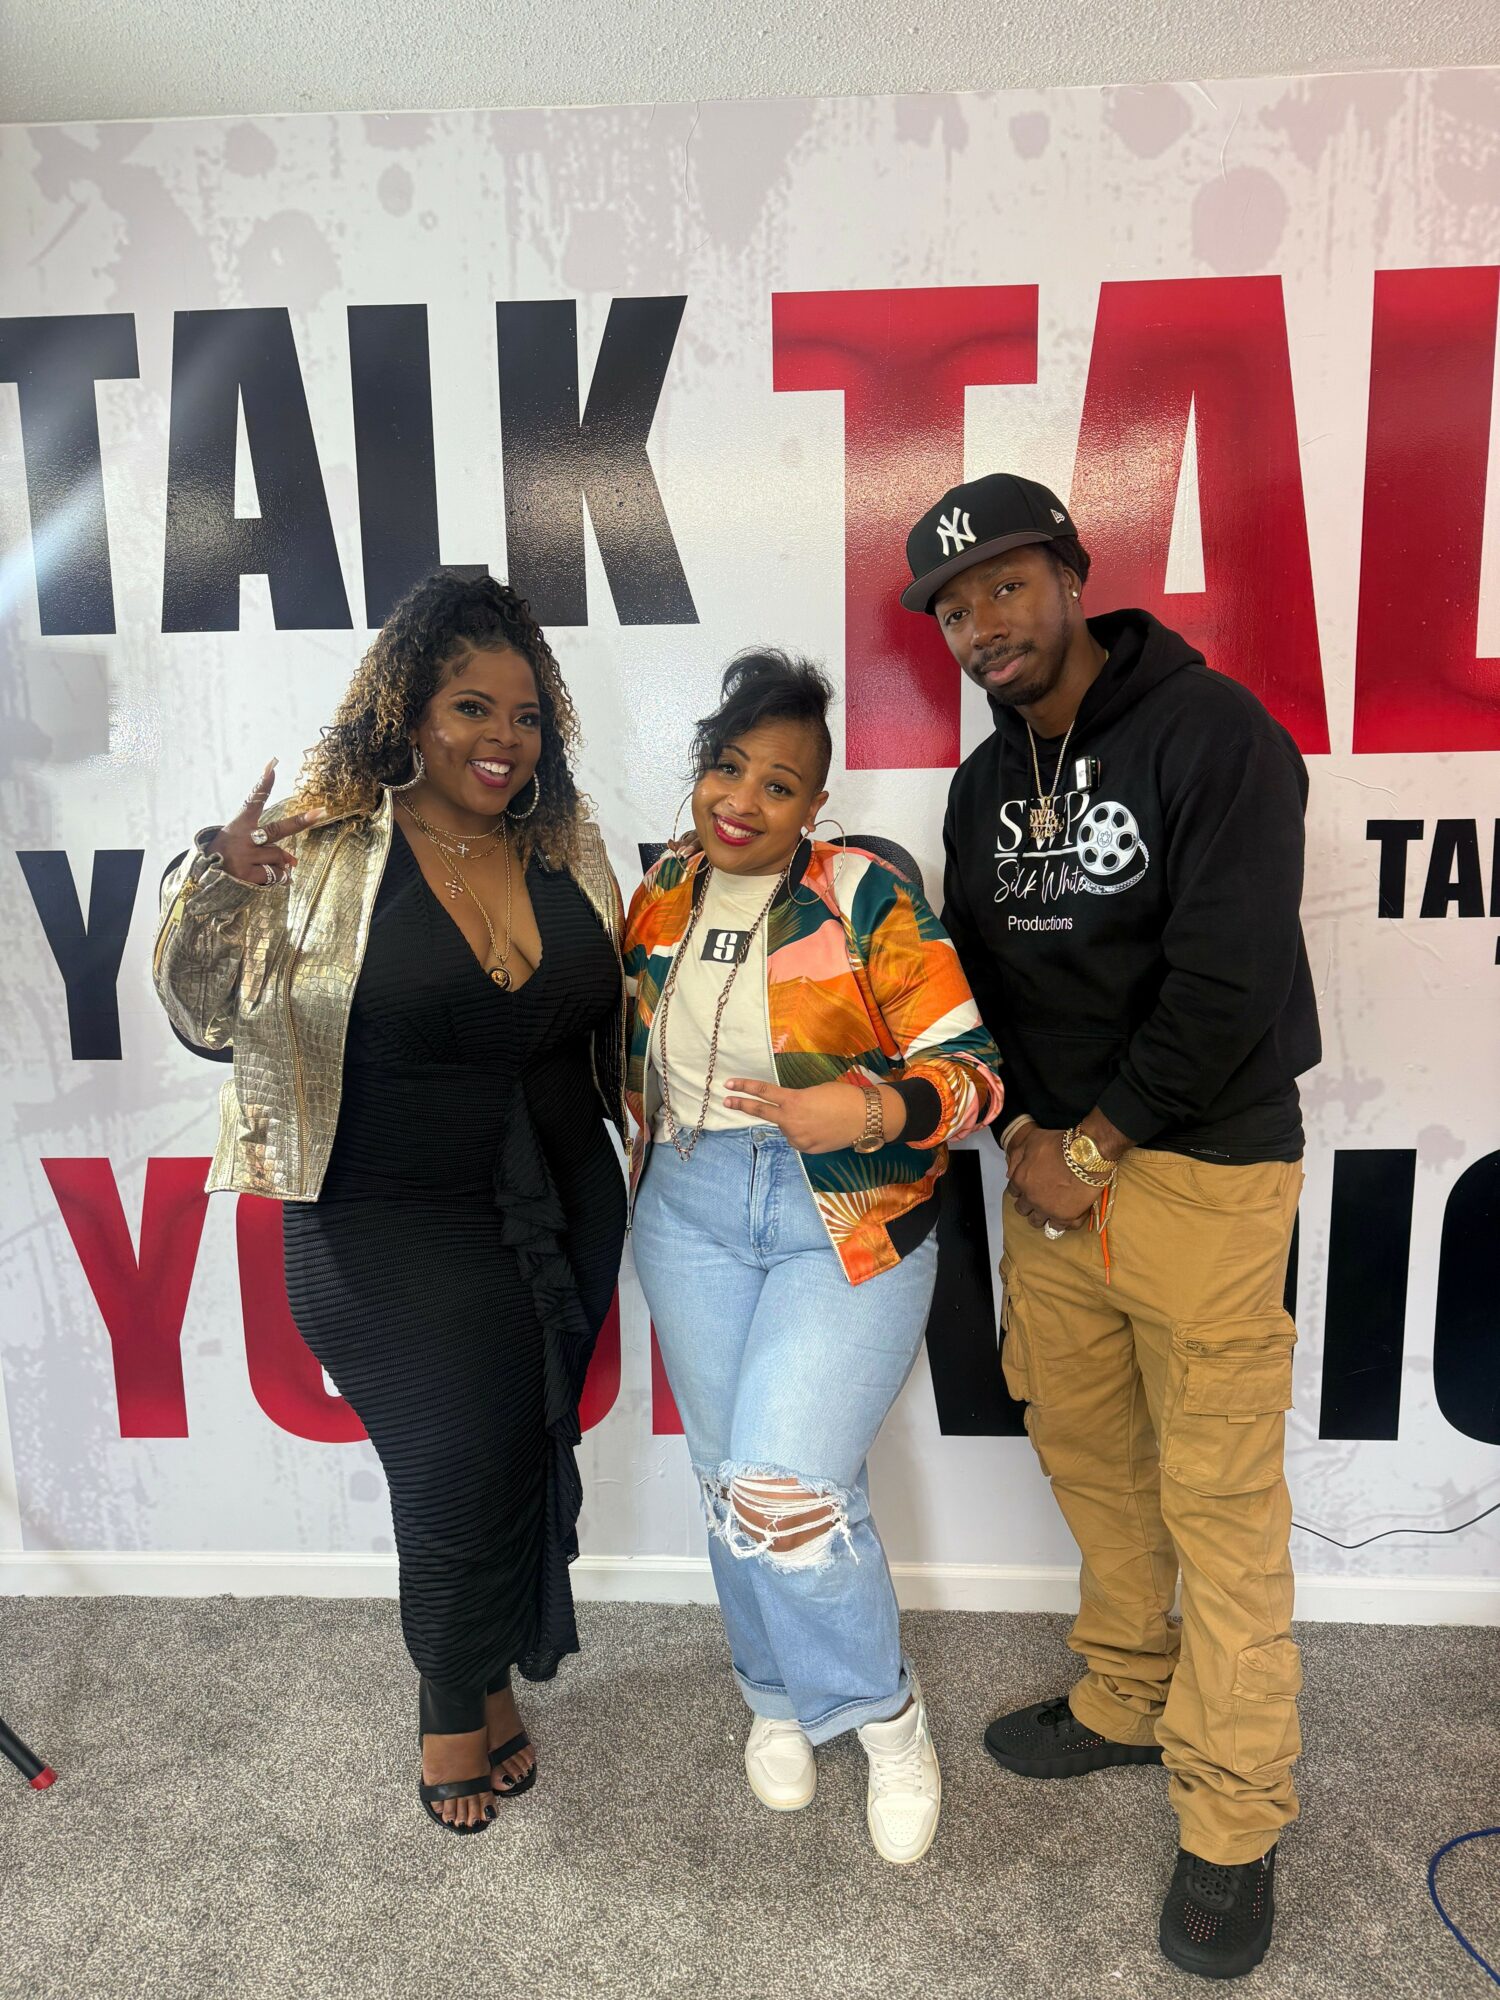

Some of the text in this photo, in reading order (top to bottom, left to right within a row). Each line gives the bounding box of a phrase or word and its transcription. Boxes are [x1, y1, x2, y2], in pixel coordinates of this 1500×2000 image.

[0, 295, 700, 636] TALK
[936, 506, 977, 557] NY
[994, 858, 1087, 904] Silk White
[1366, 818, 1500, 919] TA
[1008, 915, 1073, 931] Productions
